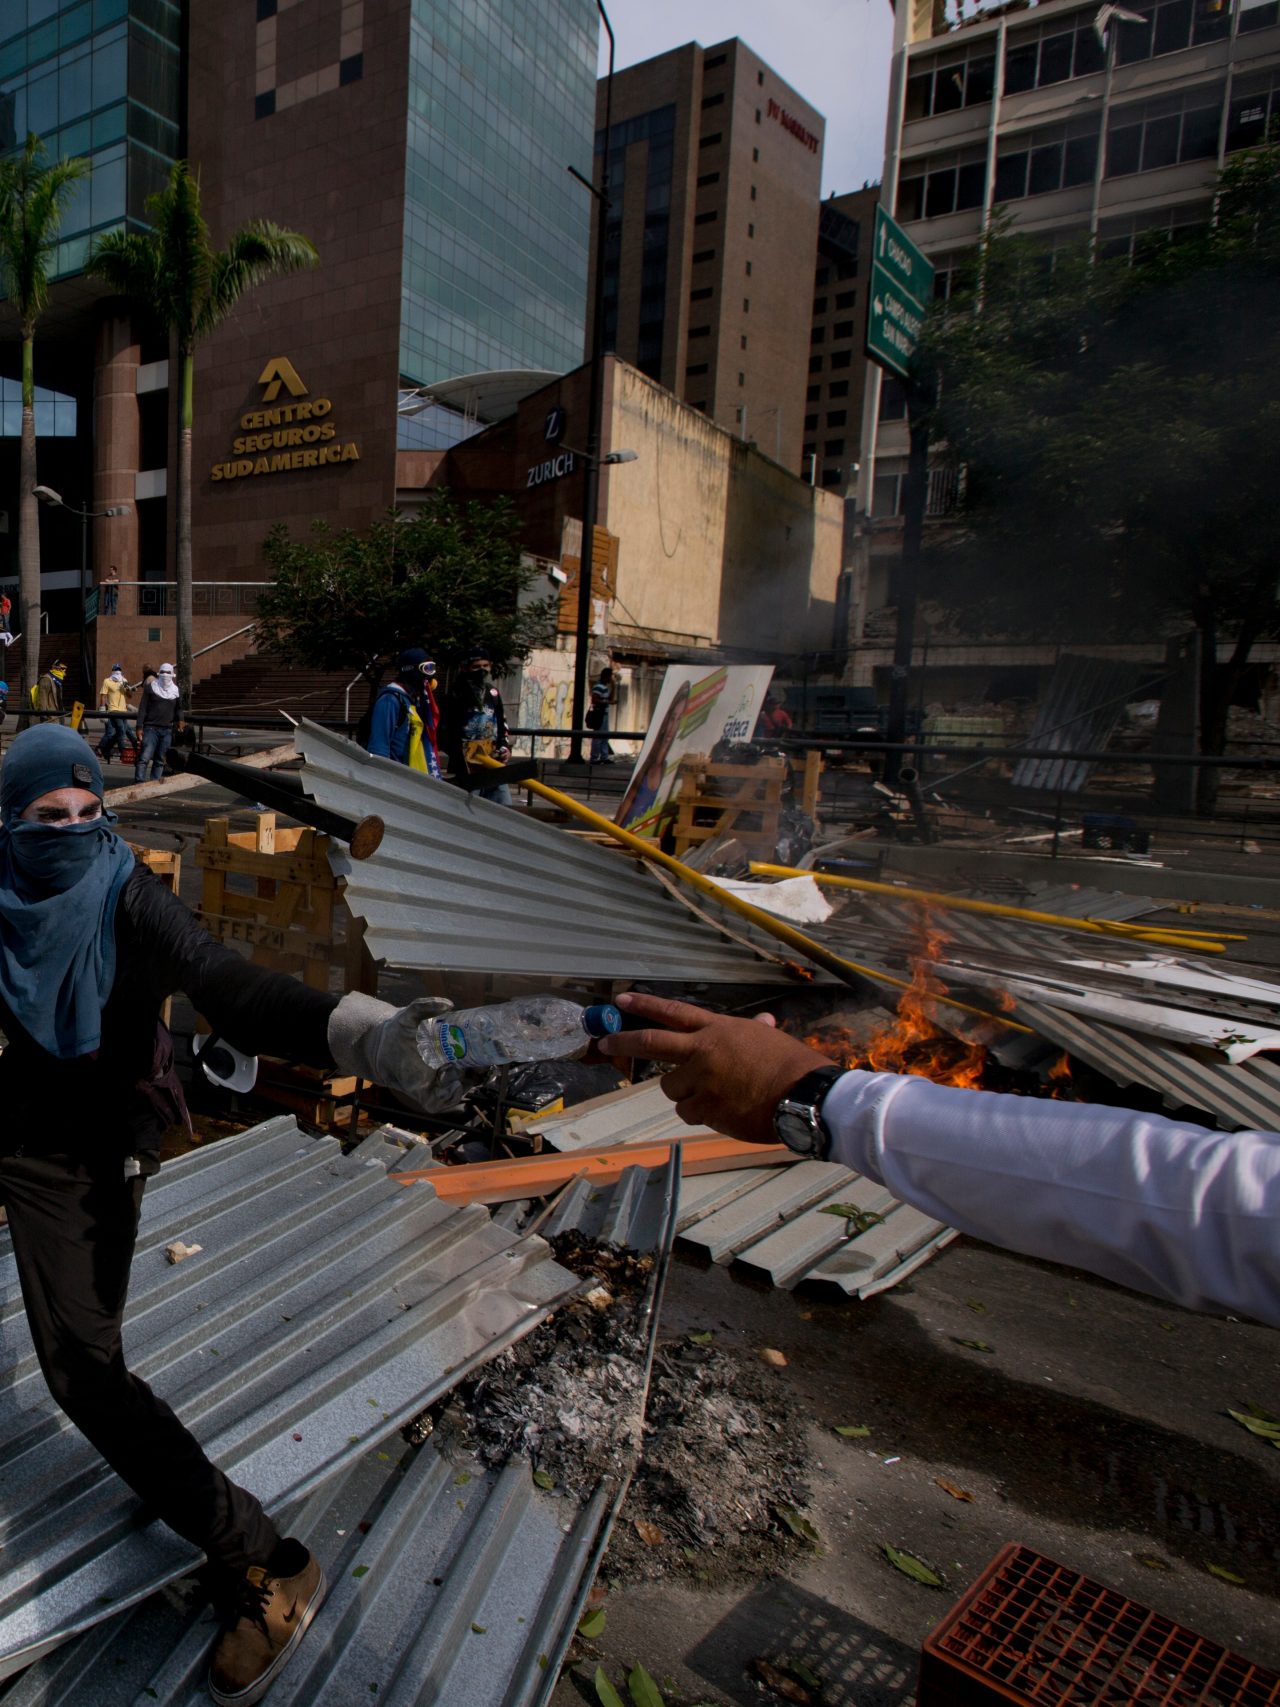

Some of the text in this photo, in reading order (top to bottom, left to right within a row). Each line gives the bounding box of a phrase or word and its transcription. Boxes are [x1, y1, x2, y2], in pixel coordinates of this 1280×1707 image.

[240, 398, 332, 431] CENTRO
[232, 422, 336, 455] SEGUROS
[210, 443, 360, 481] SUDAMERICA
[526, 453, 574, 488] ZURICH
